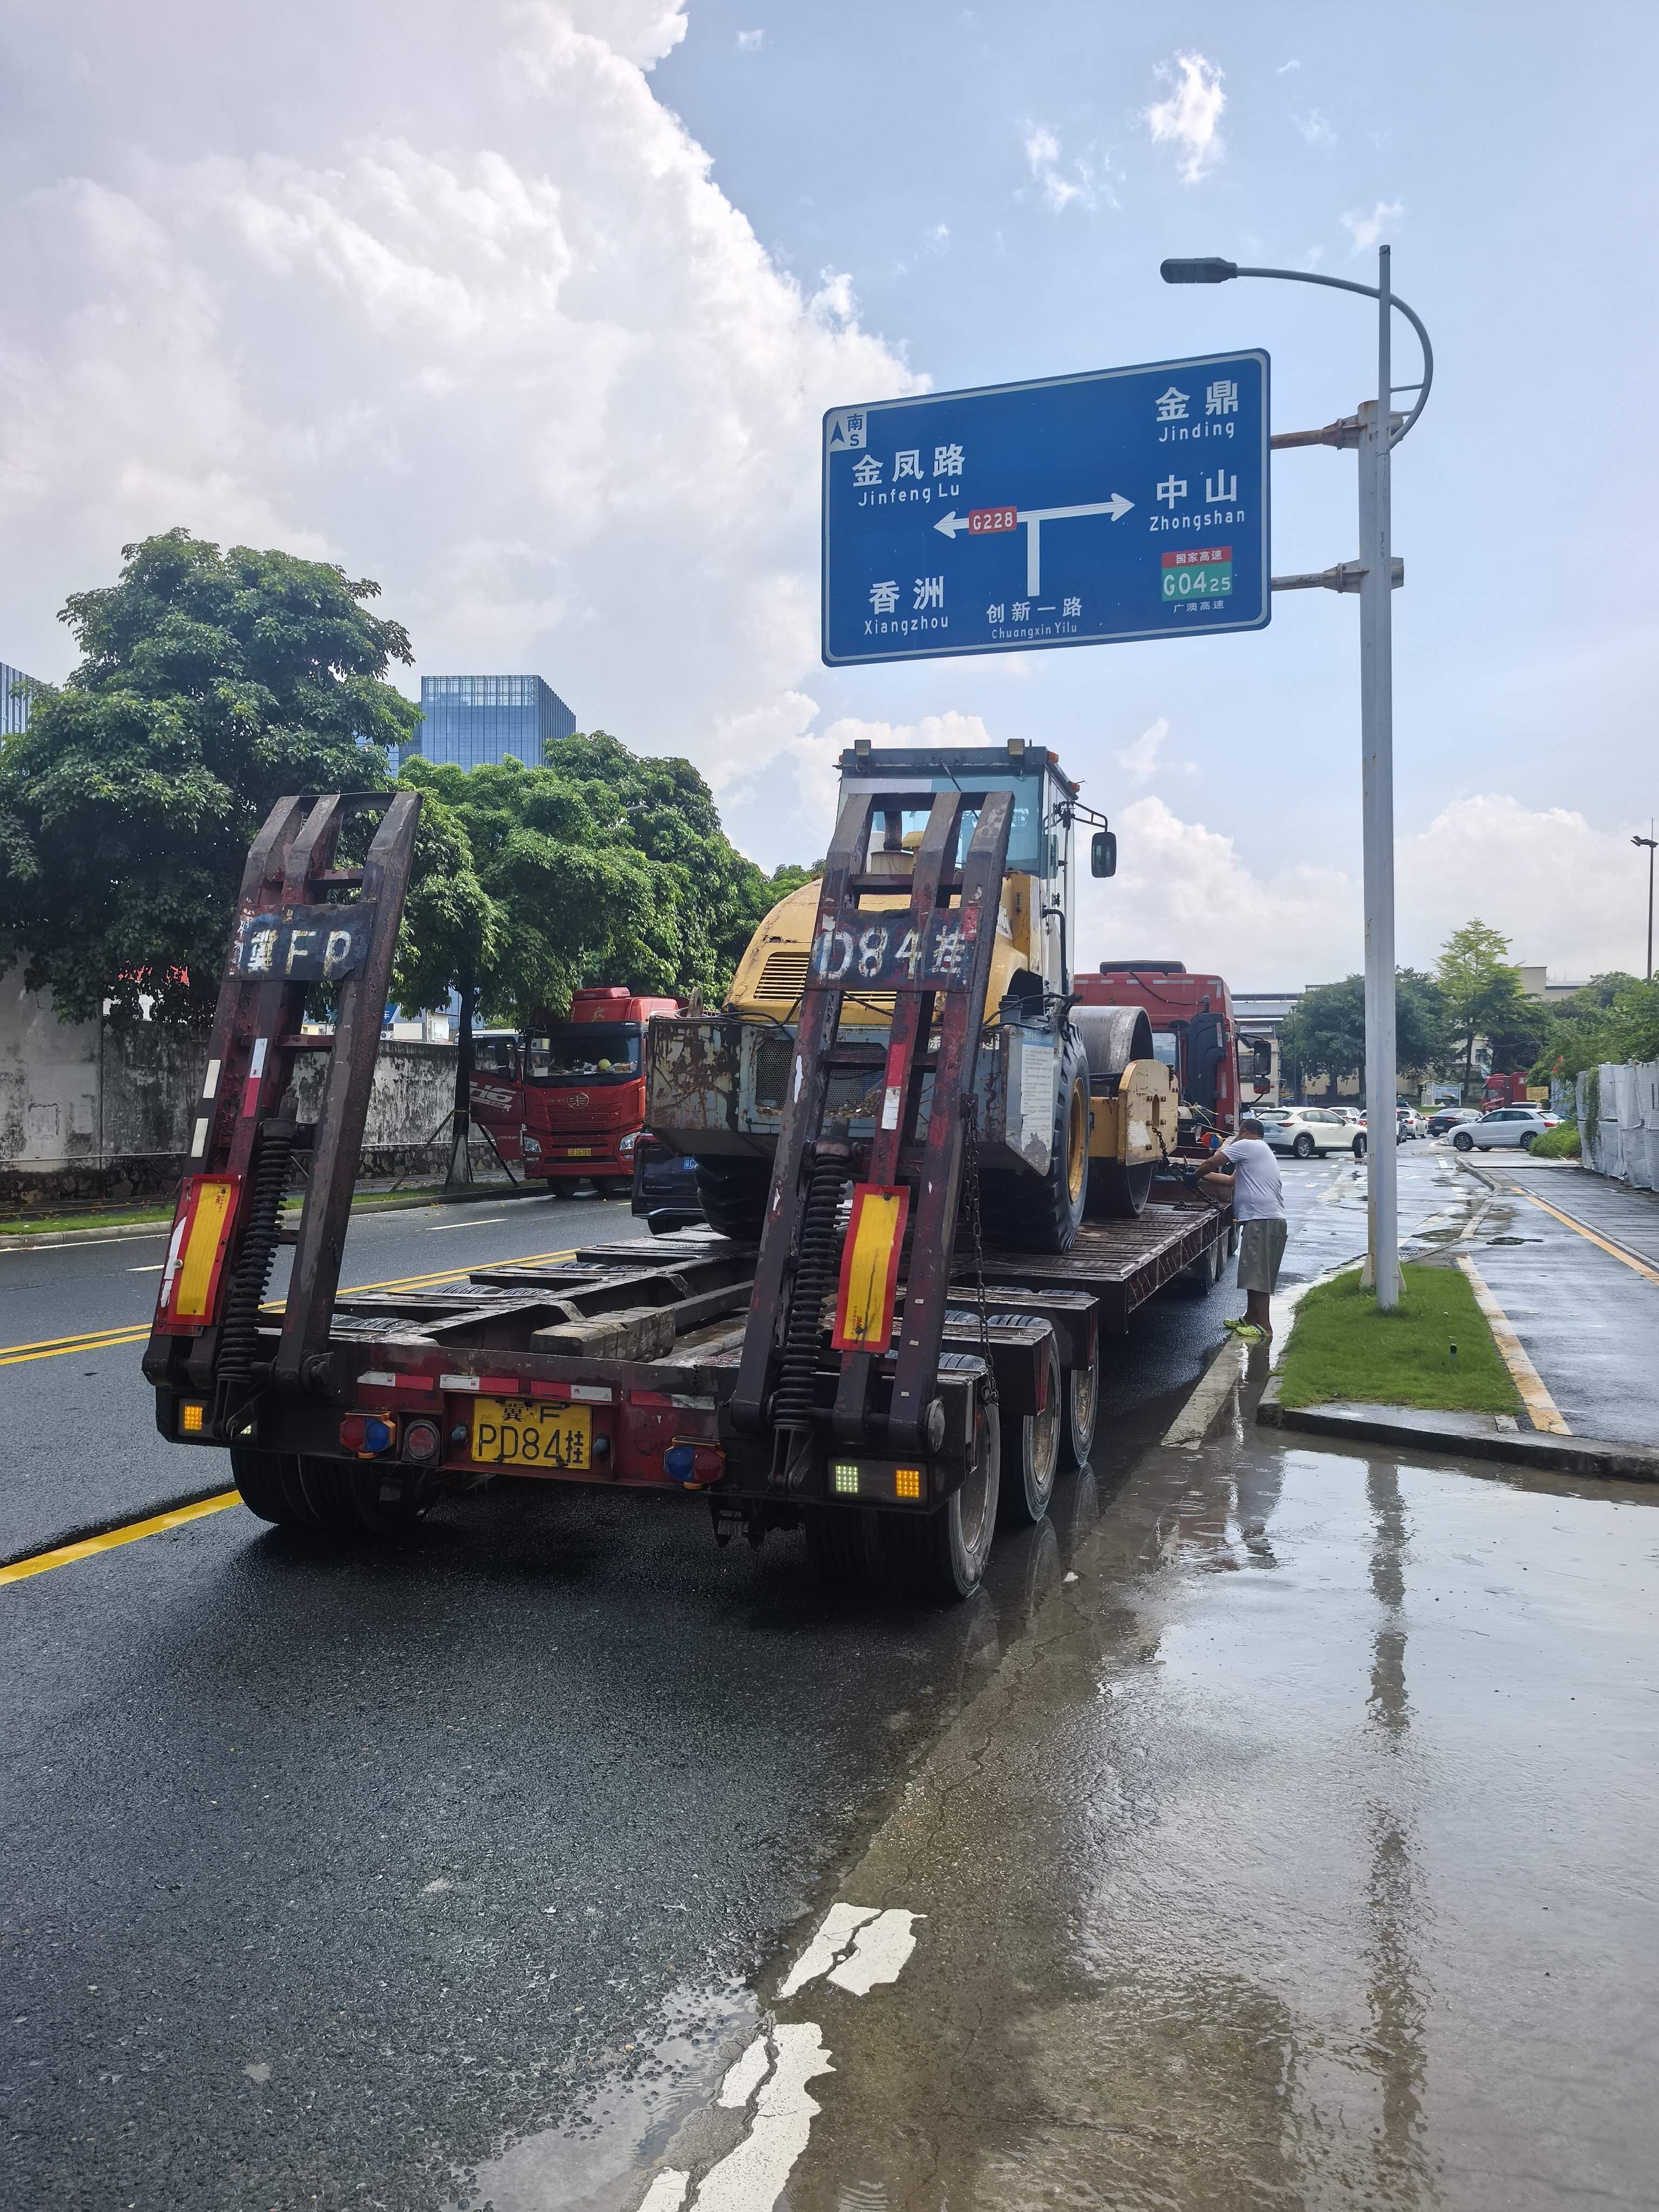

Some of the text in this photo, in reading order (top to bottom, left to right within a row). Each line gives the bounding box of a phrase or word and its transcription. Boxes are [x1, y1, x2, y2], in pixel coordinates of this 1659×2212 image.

[1155, 380, 1238, 422] 金鼎
[847, 413, 864, 433] 南
[1158, 421, 1235, 442] Jinding
[849, 434, 860, 447] S
[852, 443, 966, 487] 金凤路
[858, 483, 959, 507] Jinfeng Lu
[1156, 469, 1237, 509] 中山
[973, 511, 1013, 530] G228
[1149, 510, 1245, 531] Zhongshan
[1176, 550, 1222, 564] 国家高速
[1163, 571, 1230, 596] G0425
[868, 575, 945, 615] 香洲
[986, 596, 1082, 624] 创新一路
[1173, 600, 1224, 613] 广澳高速
[864, 615, 949, 636] Xiangzhou
[992, 621, 1077, 639] Chuangxin Yilu
[478, 1424, 584, 1464] PD84挂
